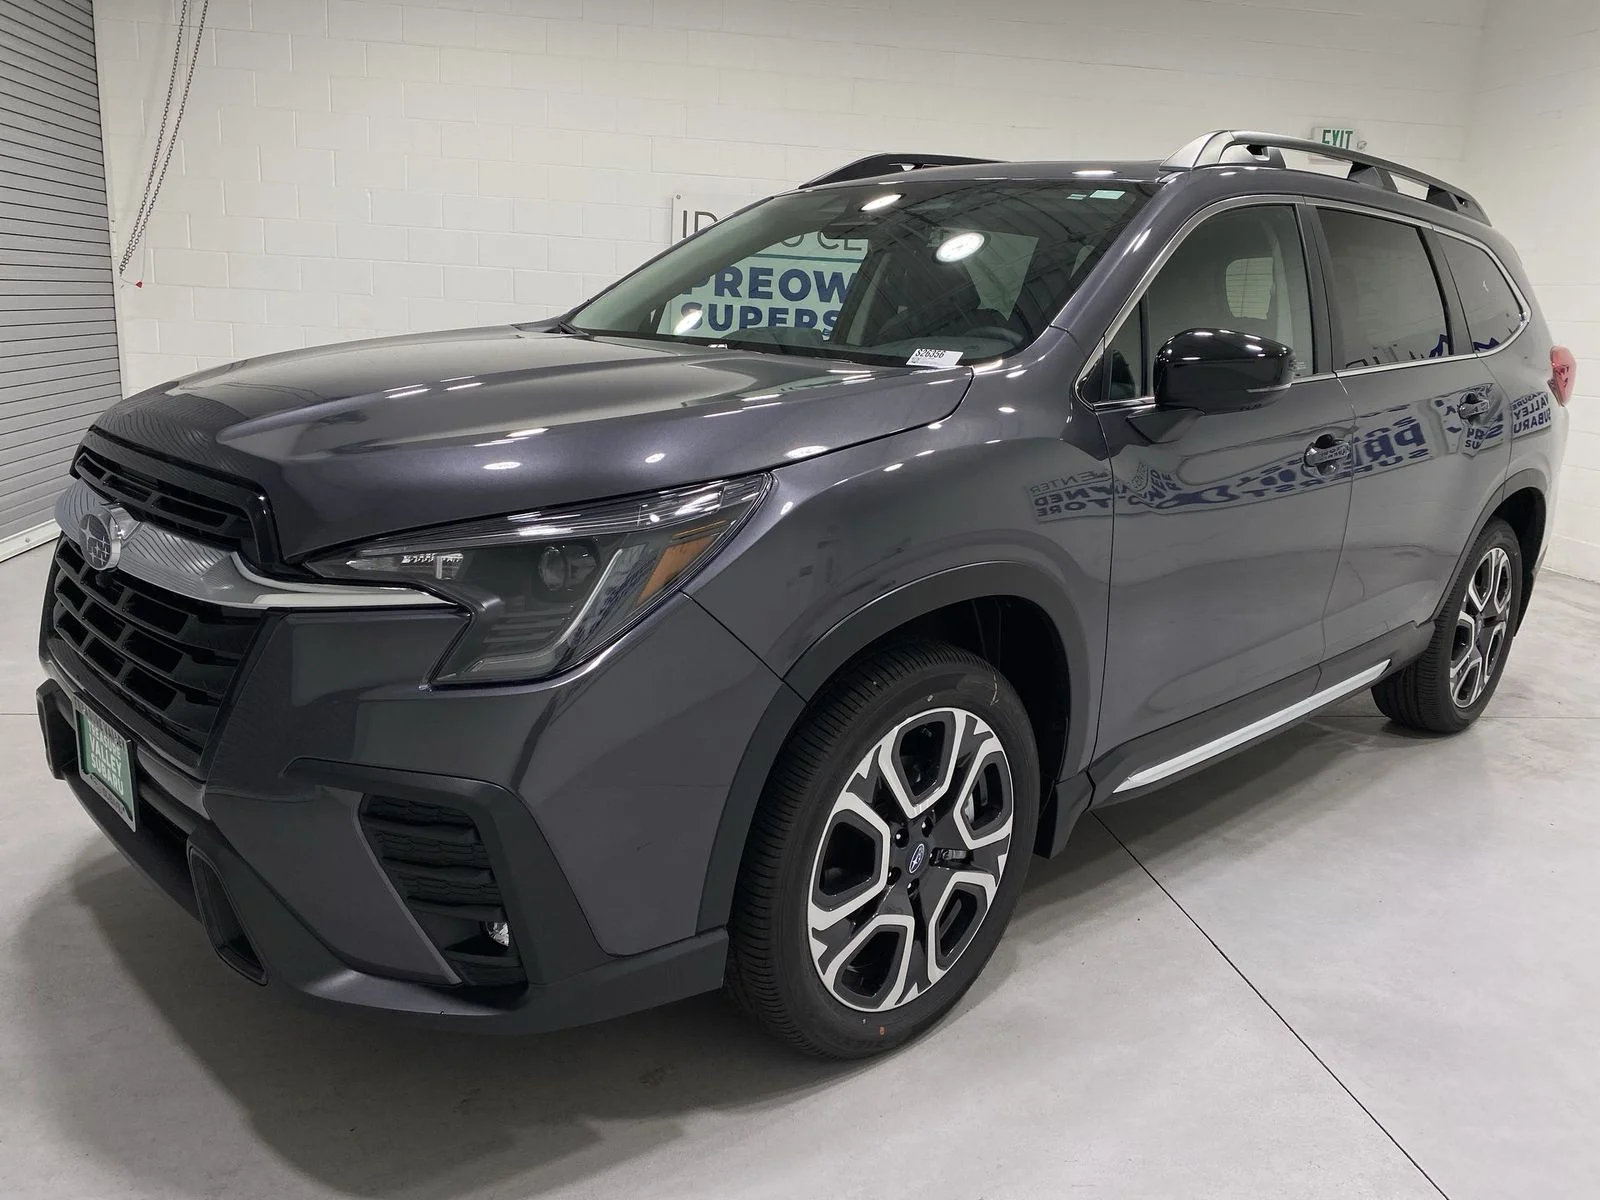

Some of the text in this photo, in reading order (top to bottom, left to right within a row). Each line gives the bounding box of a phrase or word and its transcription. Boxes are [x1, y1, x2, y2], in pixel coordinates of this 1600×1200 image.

[1322, 129, 1353, 149] EXIT
[89, 733, 122, 778] VALLEY
[91, 752, 124, 796] SUBARU
